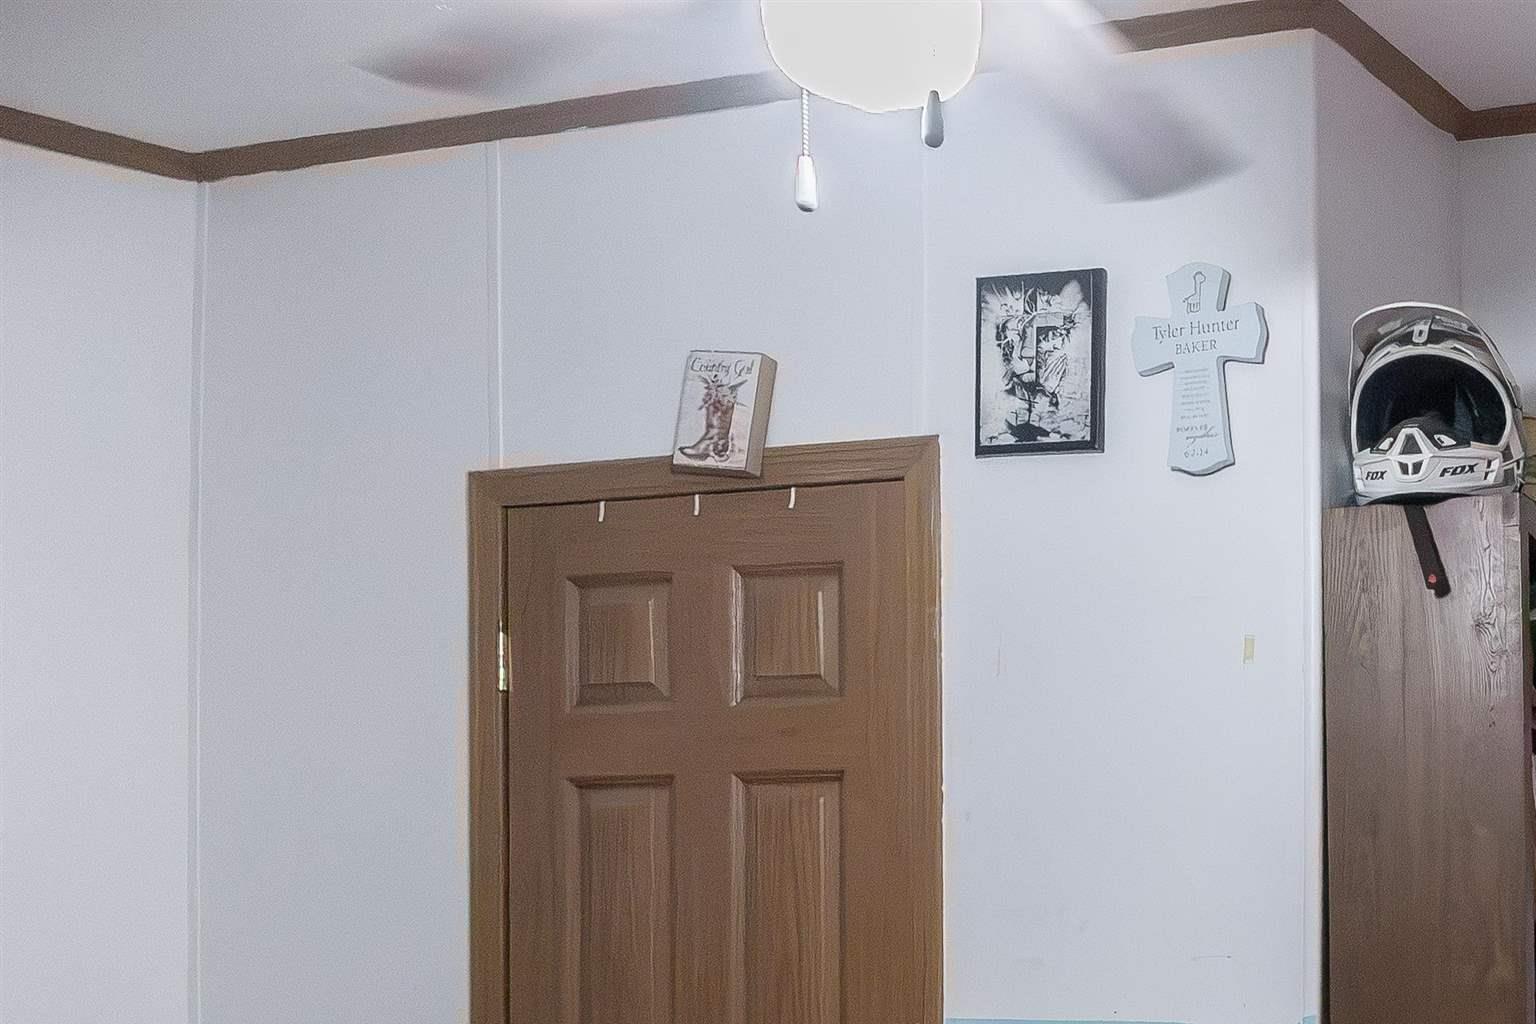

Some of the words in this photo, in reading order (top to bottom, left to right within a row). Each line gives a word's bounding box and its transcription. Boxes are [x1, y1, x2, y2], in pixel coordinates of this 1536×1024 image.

[1152, 324, 1186, 345] Tyler
[1190, 320, 1240, 338] Hunter
[1174, 339, 1218, 355] BAKER
[1365, 470, 1387, 481] FOX
[1439, 463, 1478, 477] FOX
